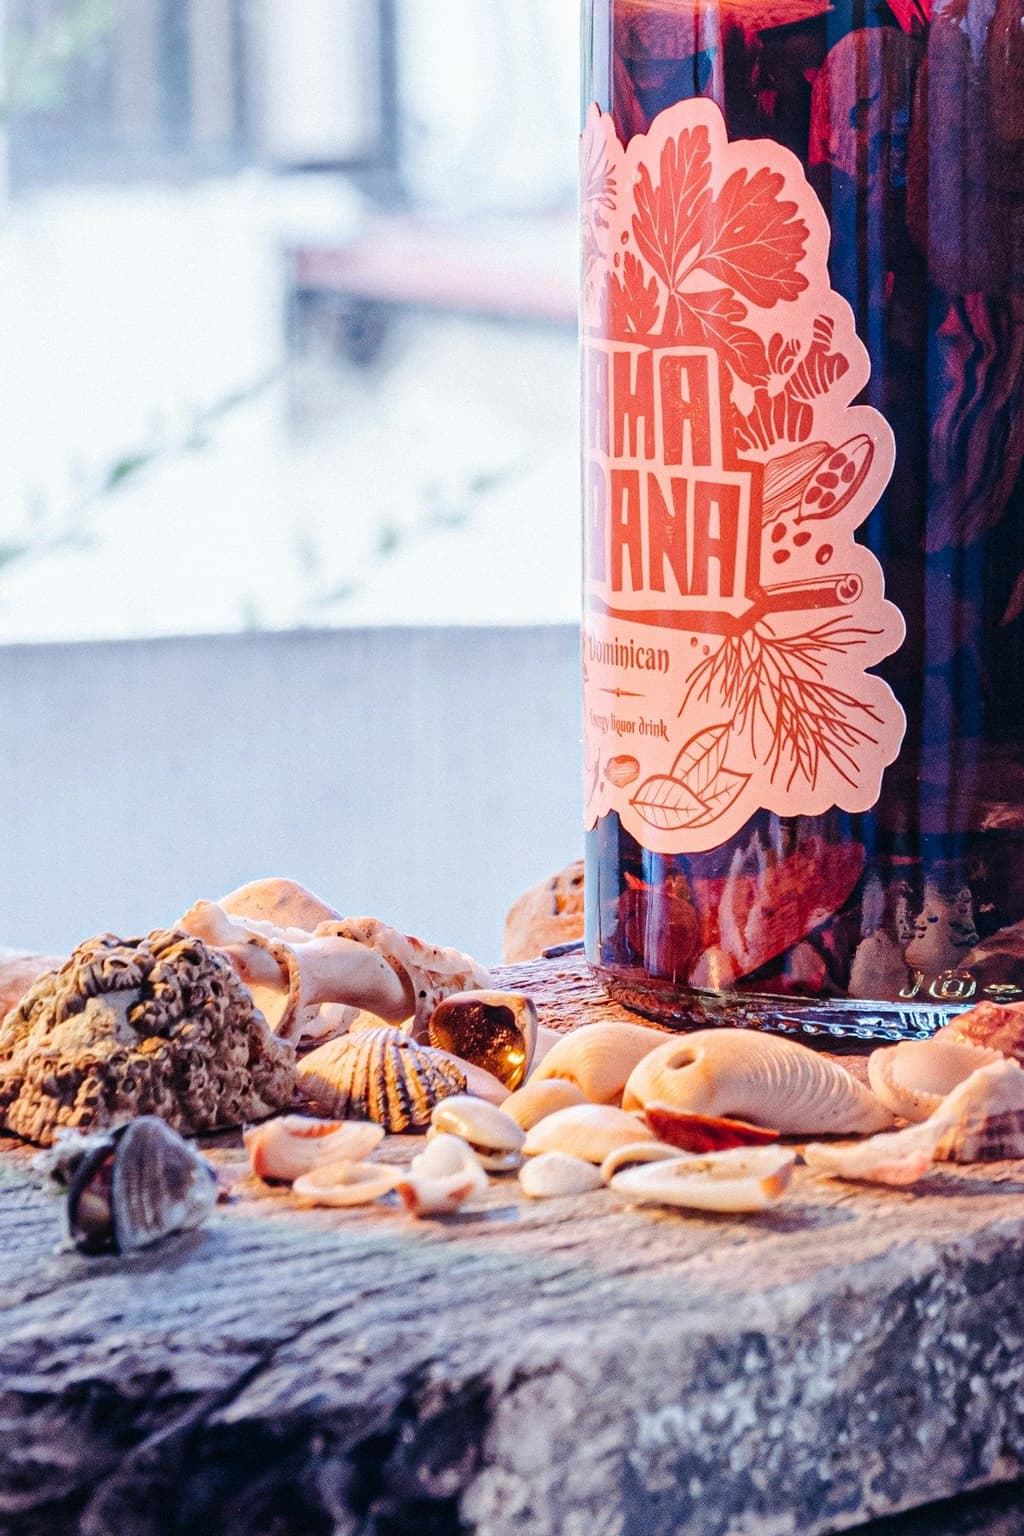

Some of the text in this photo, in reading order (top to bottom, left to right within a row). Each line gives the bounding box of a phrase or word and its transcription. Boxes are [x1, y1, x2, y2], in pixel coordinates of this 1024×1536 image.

[588, 634, 670, 674] Dominican
[610, 711, 636, 738] liquor
[638, 715, 670, 742] drink
